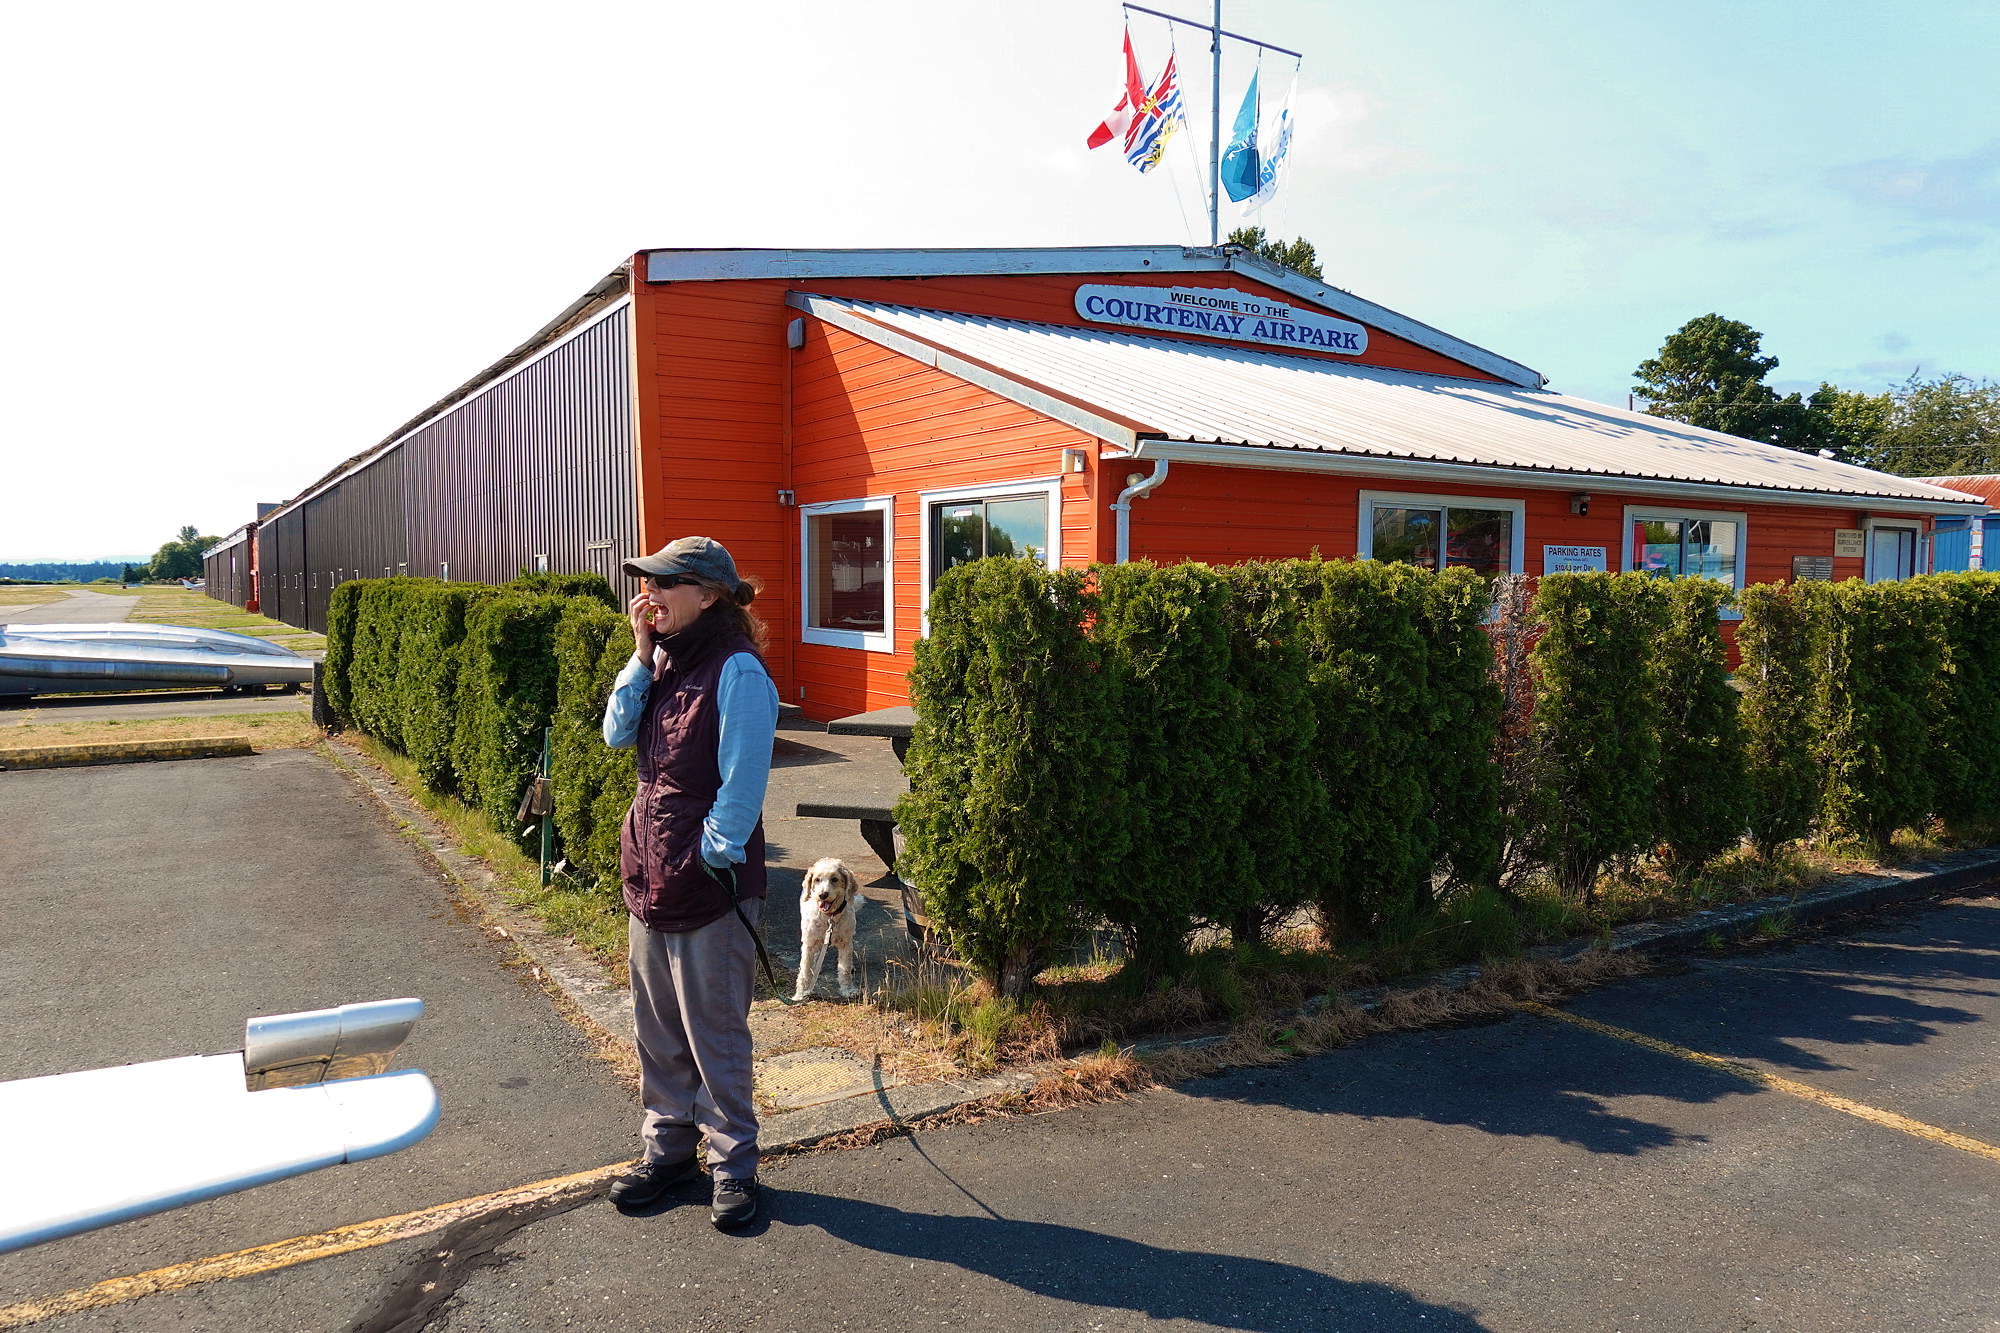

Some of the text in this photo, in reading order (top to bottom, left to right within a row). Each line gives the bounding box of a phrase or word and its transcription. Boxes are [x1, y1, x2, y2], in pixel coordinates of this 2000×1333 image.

[1170, 292, 1289, 318] WELCOME TO THE
[1086, 295, 1359, 350] COURTENAY AIRPARK
[1548, 547, 1601, 557] PARKING RATES
